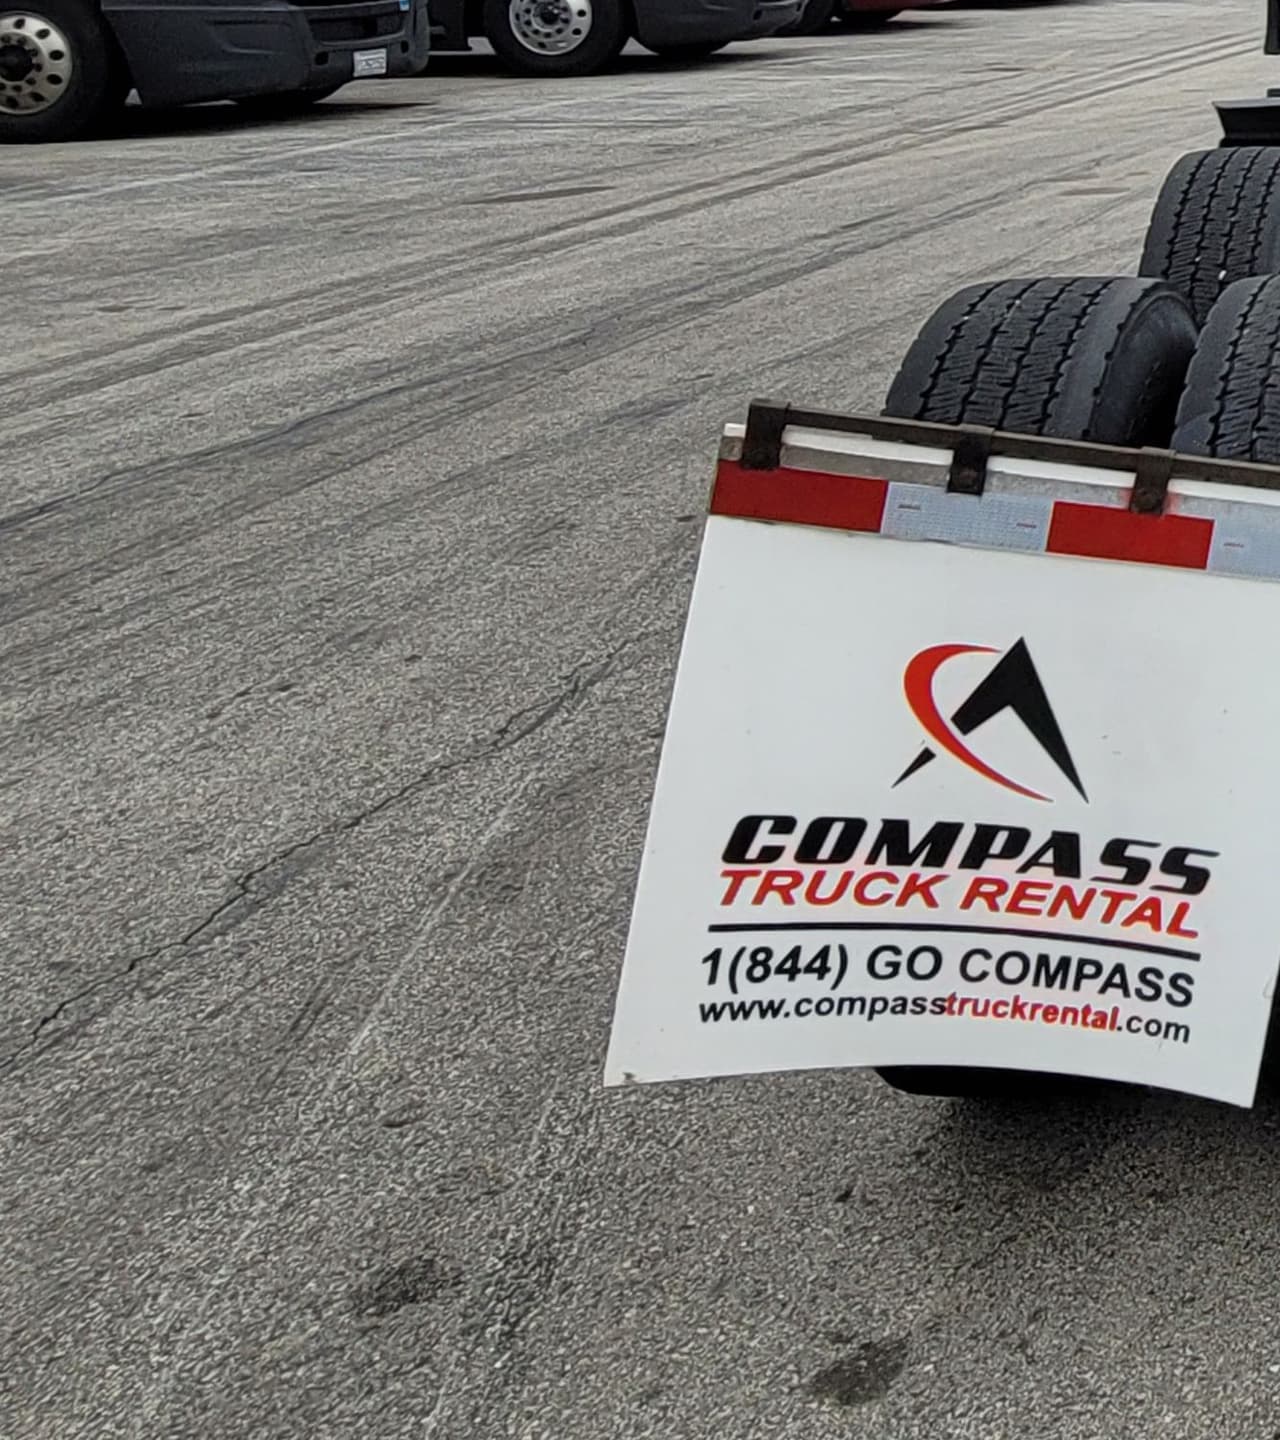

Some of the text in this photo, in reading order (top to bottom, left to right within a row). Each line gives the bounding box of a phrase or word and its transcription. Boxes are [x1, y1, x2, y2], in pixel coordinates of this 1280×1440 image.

[719, 813, 1221, 896] COMPASS
[719, 868, 1200, 940] TRUCK RENTAL
[700, 943, 1196, 1009] 1(844) GO COMPASS
[698, 991, 1191, 1044] www.compasstruckrental.com
